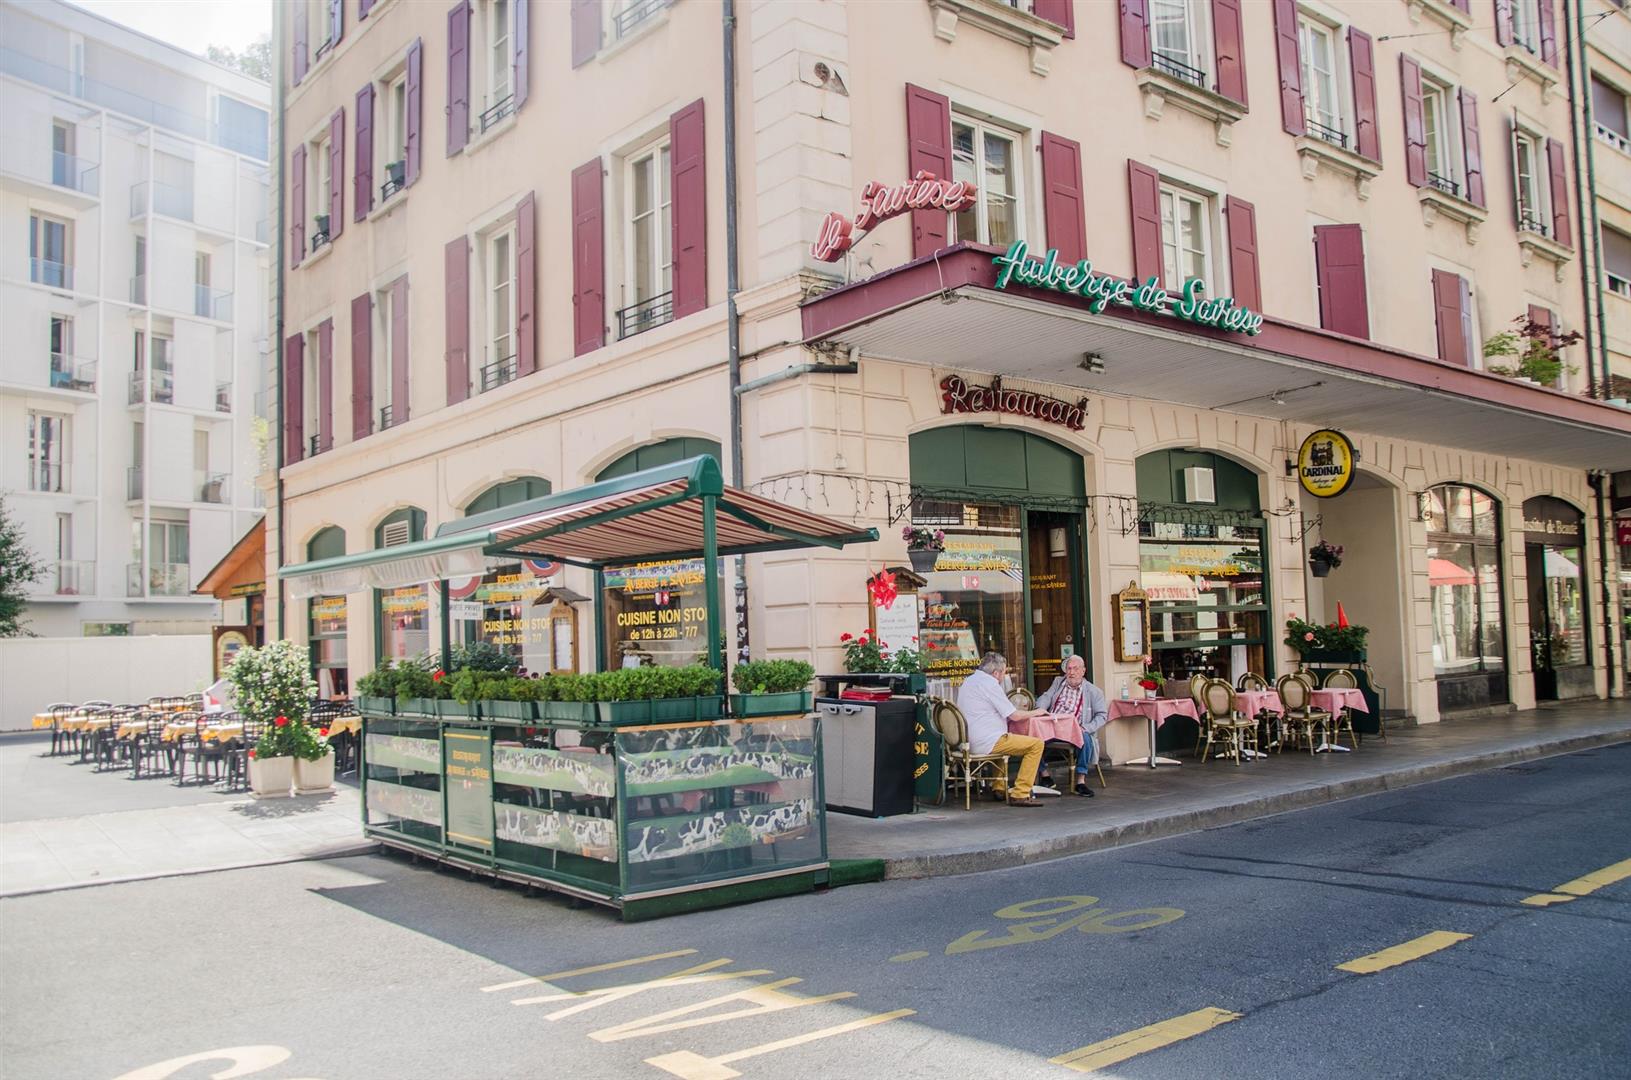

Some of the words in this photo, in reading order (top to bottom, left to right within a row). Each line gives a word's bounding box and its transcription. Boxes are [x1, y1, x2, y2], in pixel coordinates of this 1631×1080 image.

[992, 240, 1128, 314] Auberge
[1131, 276, 1170, 312] de
[940, 374, 1089, 432] Restaurant
[1302, 466, 1345, 477] CARDINAL
[617, 610, 656, 626] CUISINE
[658, 609, 681, 625] NON
[684, 607, 707, 622] STO
[484, 620, 513, 633] CUISINE
[513, 619, 529, 631] NON
[630, 629, 640, 640] de
[641, 628, 655, 639] 12h
[656, 628, 662, 638] à
[663, 627, 678, 639] 23h
[685, 626, 698, 638] 7/7
[953, 659, 968, 667] NON
[969, 658, 983, 666] STO
